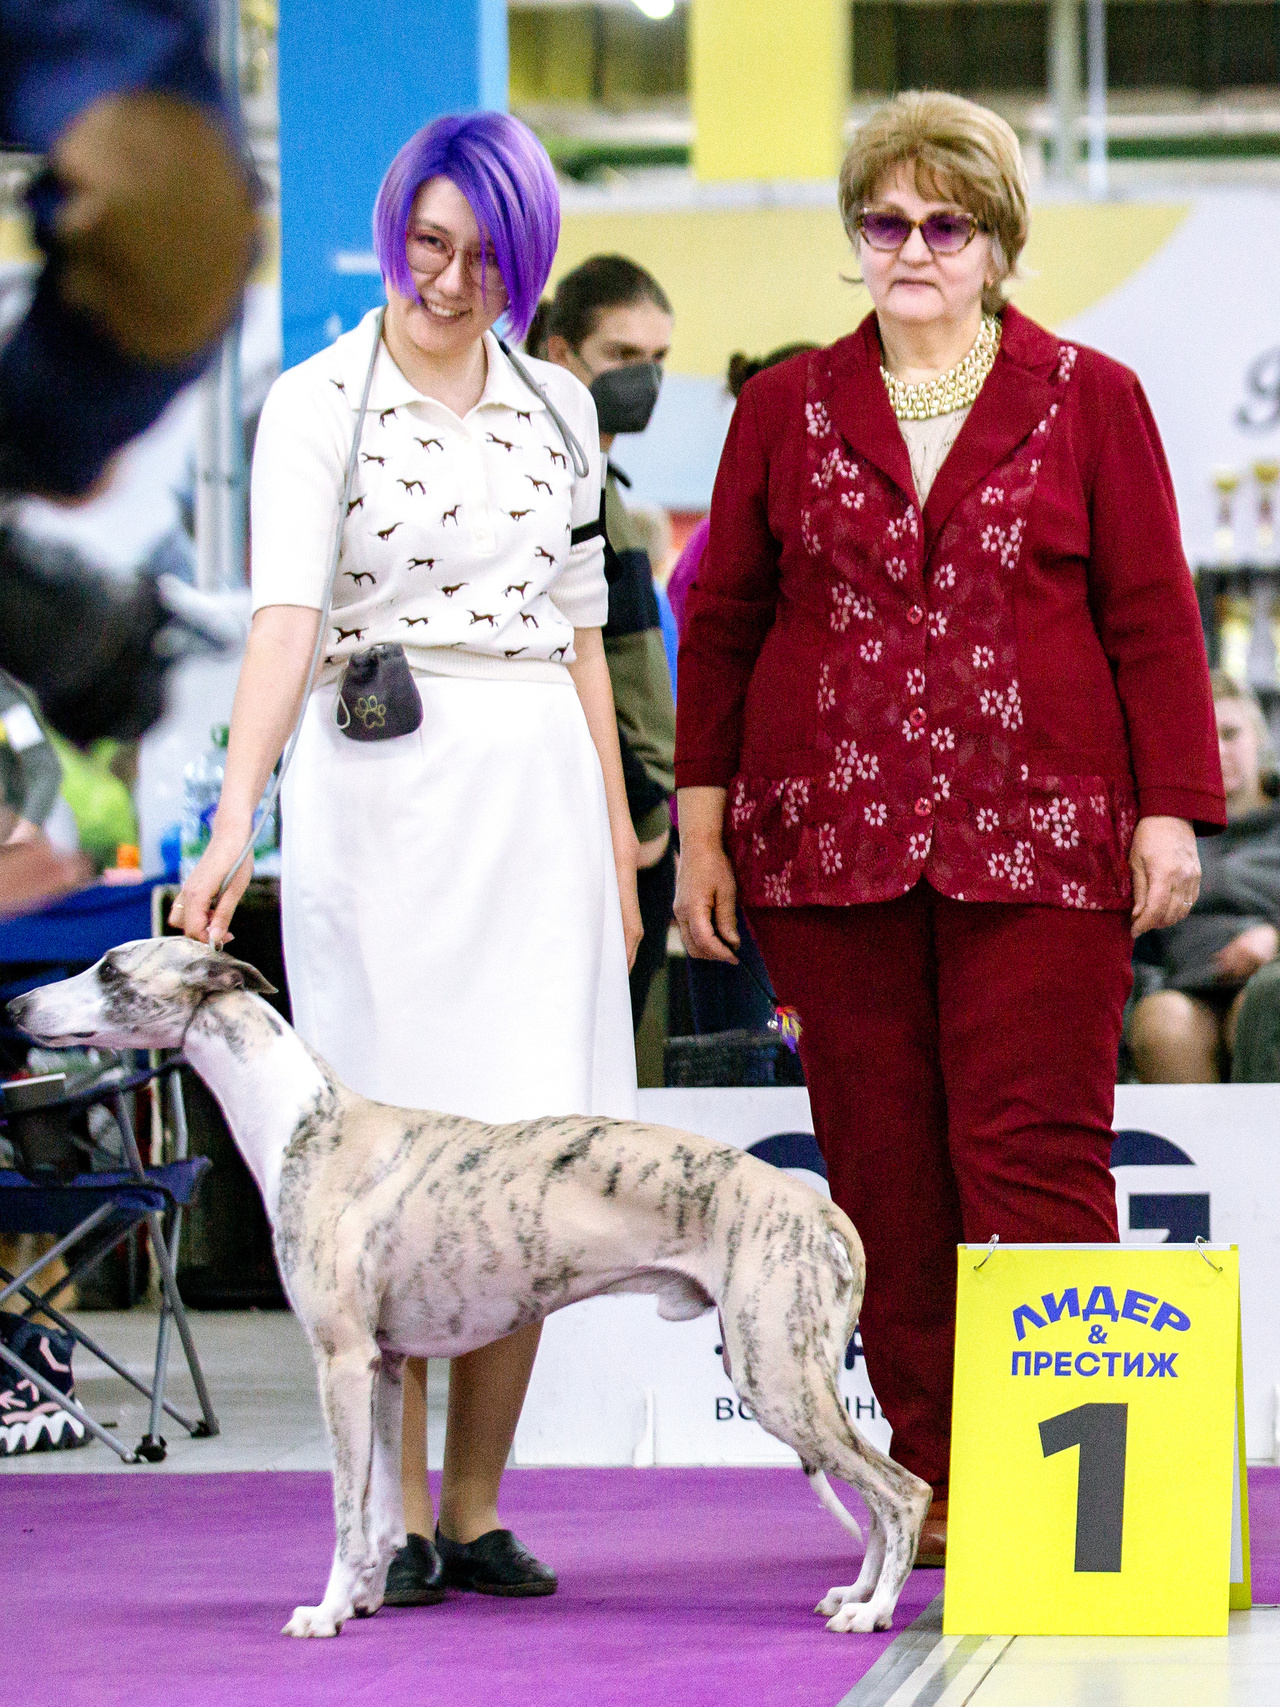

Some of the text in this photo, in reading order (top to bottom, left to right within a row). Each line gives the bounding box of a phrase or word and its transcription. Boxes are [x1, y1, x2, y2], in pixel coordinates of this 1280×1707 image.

[1012, 1286, 1192, 1341] ЛИДЕР
[1088, 1325, 1109, 1346] &
[1011, 1351, 1180, 1379] ПРЕСТИЖ
[1038, 1402, 1129, 1574] 1
